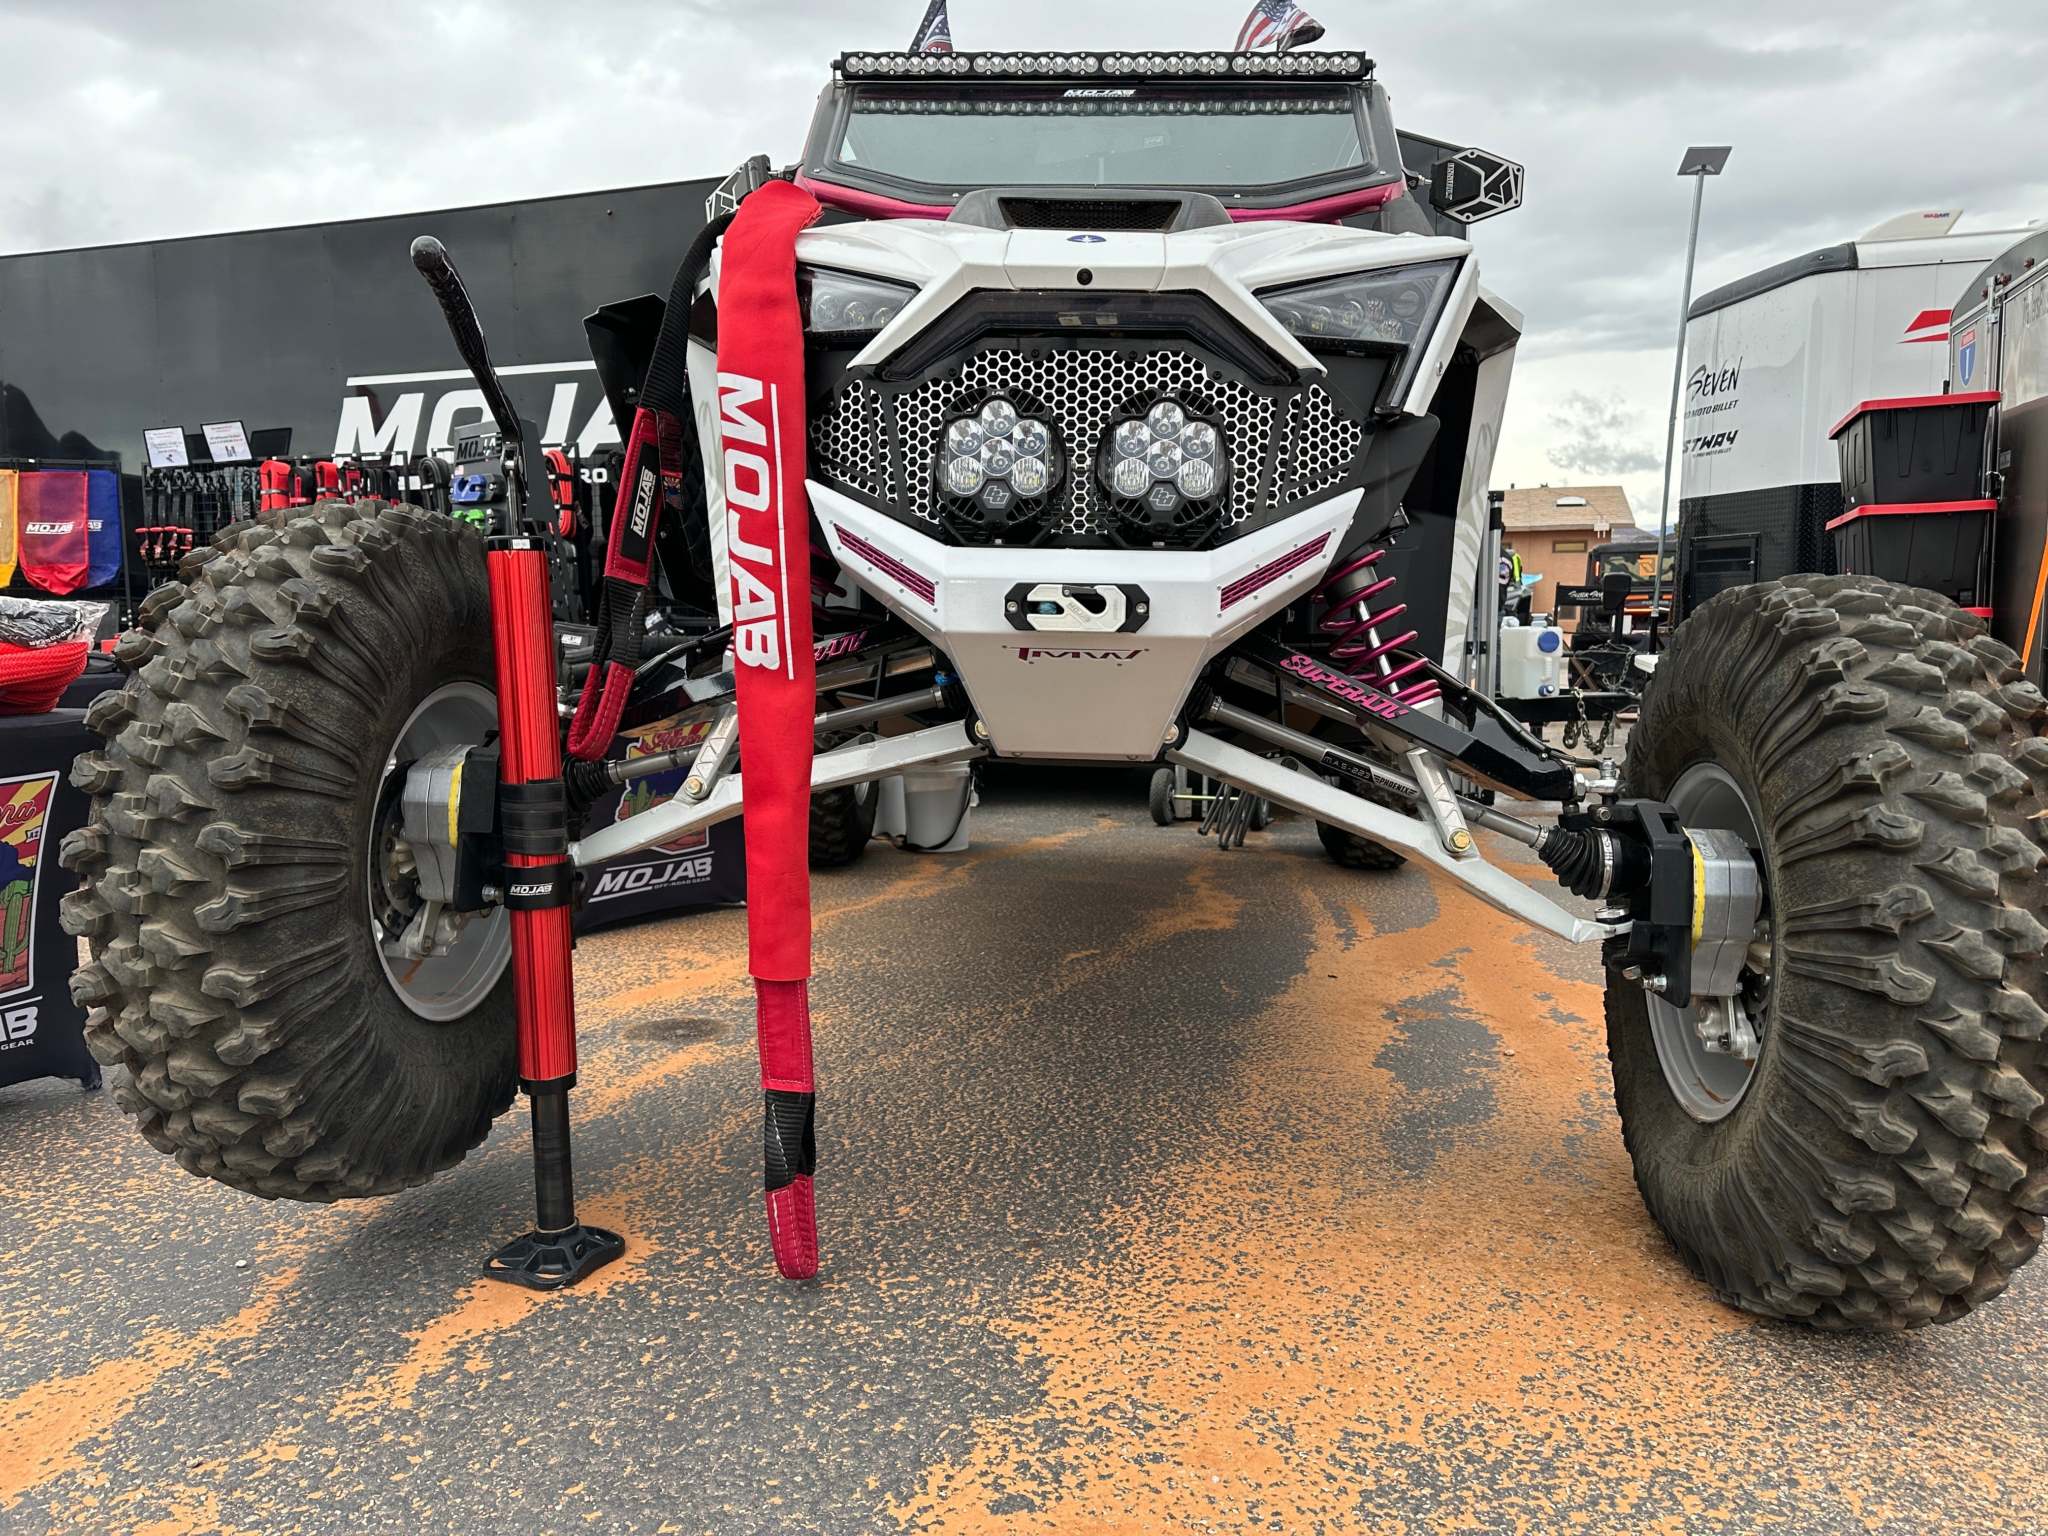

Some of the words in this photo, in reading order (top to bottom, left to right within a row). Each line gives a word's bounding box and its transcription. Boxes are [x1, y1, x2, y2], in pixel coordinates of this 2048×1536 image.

[1686, 356, 1743, 400] SEVEN
[632, 468, 655, 537] MOJAB
[717, 372, 781, 671] MOJAB
[1379, 776, 1409, 795] PHOENIX
[510, 883, 553, 894] MOJAB
[593, 857, 712, 896] MOJAB
[0, 1038, 35, 1051] GEAR
